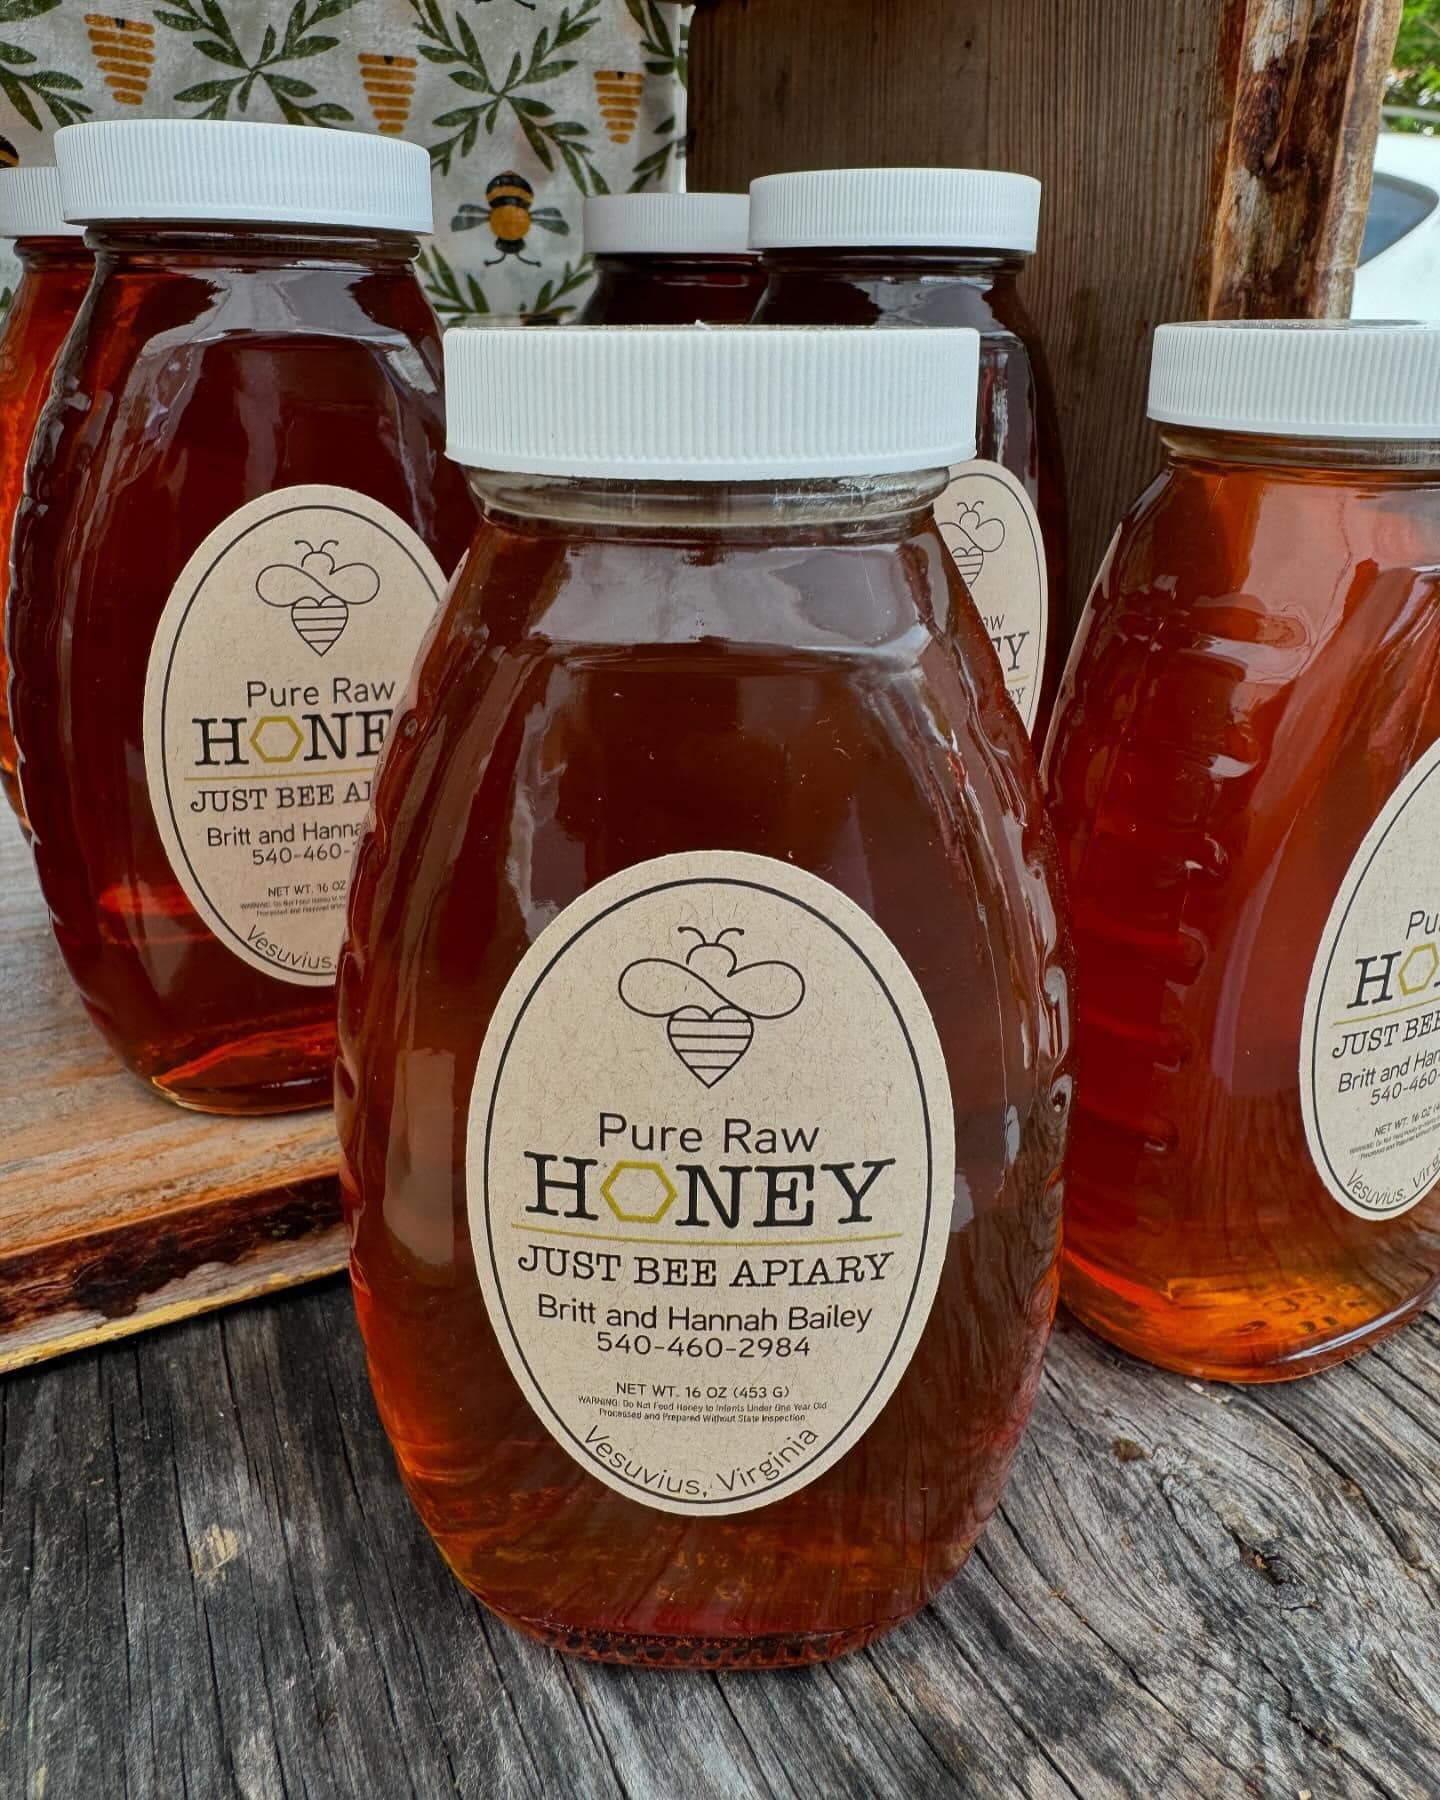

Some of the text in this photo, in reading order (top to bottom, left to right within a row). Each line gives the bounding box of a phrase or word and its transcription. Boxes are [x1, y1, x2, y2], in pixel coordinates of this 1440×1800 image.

[247, 677, 396, 708] Pure Raw
[189, 788, 268, 813] JUST
[275, 783, 335, 808] BEE
[206, 826, 252, 848] Britt
[258, 823, 295, 845] and
[267, 885, 290, 897] NET
[294, 883, 314, 895] WT.
[317, 882, 329, 893] 16
[1405, 909, 1440, 940] Pu
[1332, 1022, 1400, 1059] JUST
[1338, 1066, 1377, 1093] Britt
[1380, 1055, 1412, 1083] and
[599, 1111, 820, 1154] Pure Raw
[1374, 1121, 1393, 1137] NET
[523, 1150, 897, 1229] HONEY
[517, 1244, 895, 1288] JUST BEE APIARY
[537, 1293, 873, 1334] Britt and Hannah Bailey
[596, 1331, 811, 1358] 540-460-2984
[616, 1381, 791, 1399] NET WT. 16 OZ (453 G)
[599, 1407, 807, 1424] Processed and Prepared Without State Inspection
[622, 1399, 634, 1409] Do
[676, 1402, 704, 1413] Honey
[705, 1403, 715, 1413] to
[746, 1403, 773, 1413] Under
[774, 1402, 792, 1413] One
[793, 1402, 812, 1412] Year
[813, 1401, 828, 1411] Old
[584, 1424, 819, 1499] Vesuvius, Virginia
